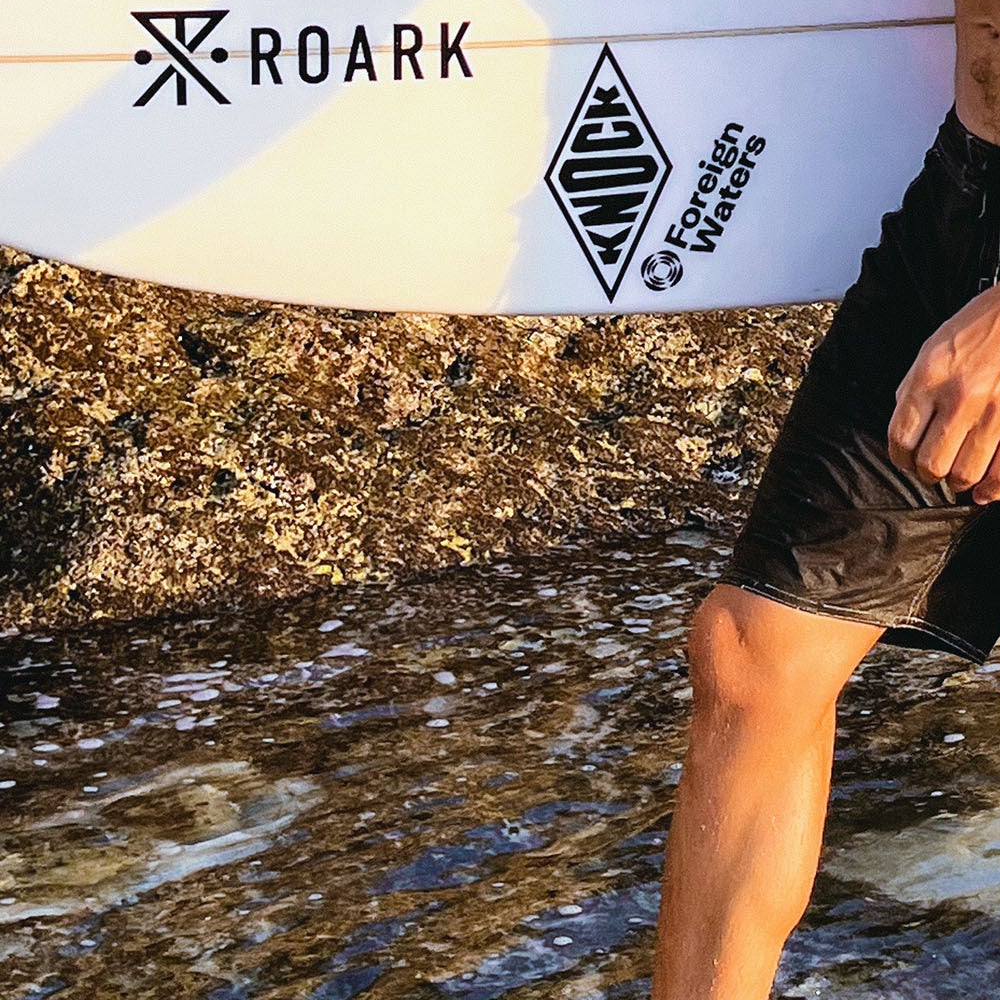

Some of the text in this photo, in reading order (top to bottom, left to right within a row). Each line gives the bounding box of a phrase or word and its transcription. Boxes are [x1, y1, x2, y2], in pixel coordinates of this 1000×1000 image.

[250, 22, 473, 86] ROARK
[558, 84, 659, 266] KNOCK
[664, 122, 745, 250] Foreign
[689, 134, 767, 253] Waters
